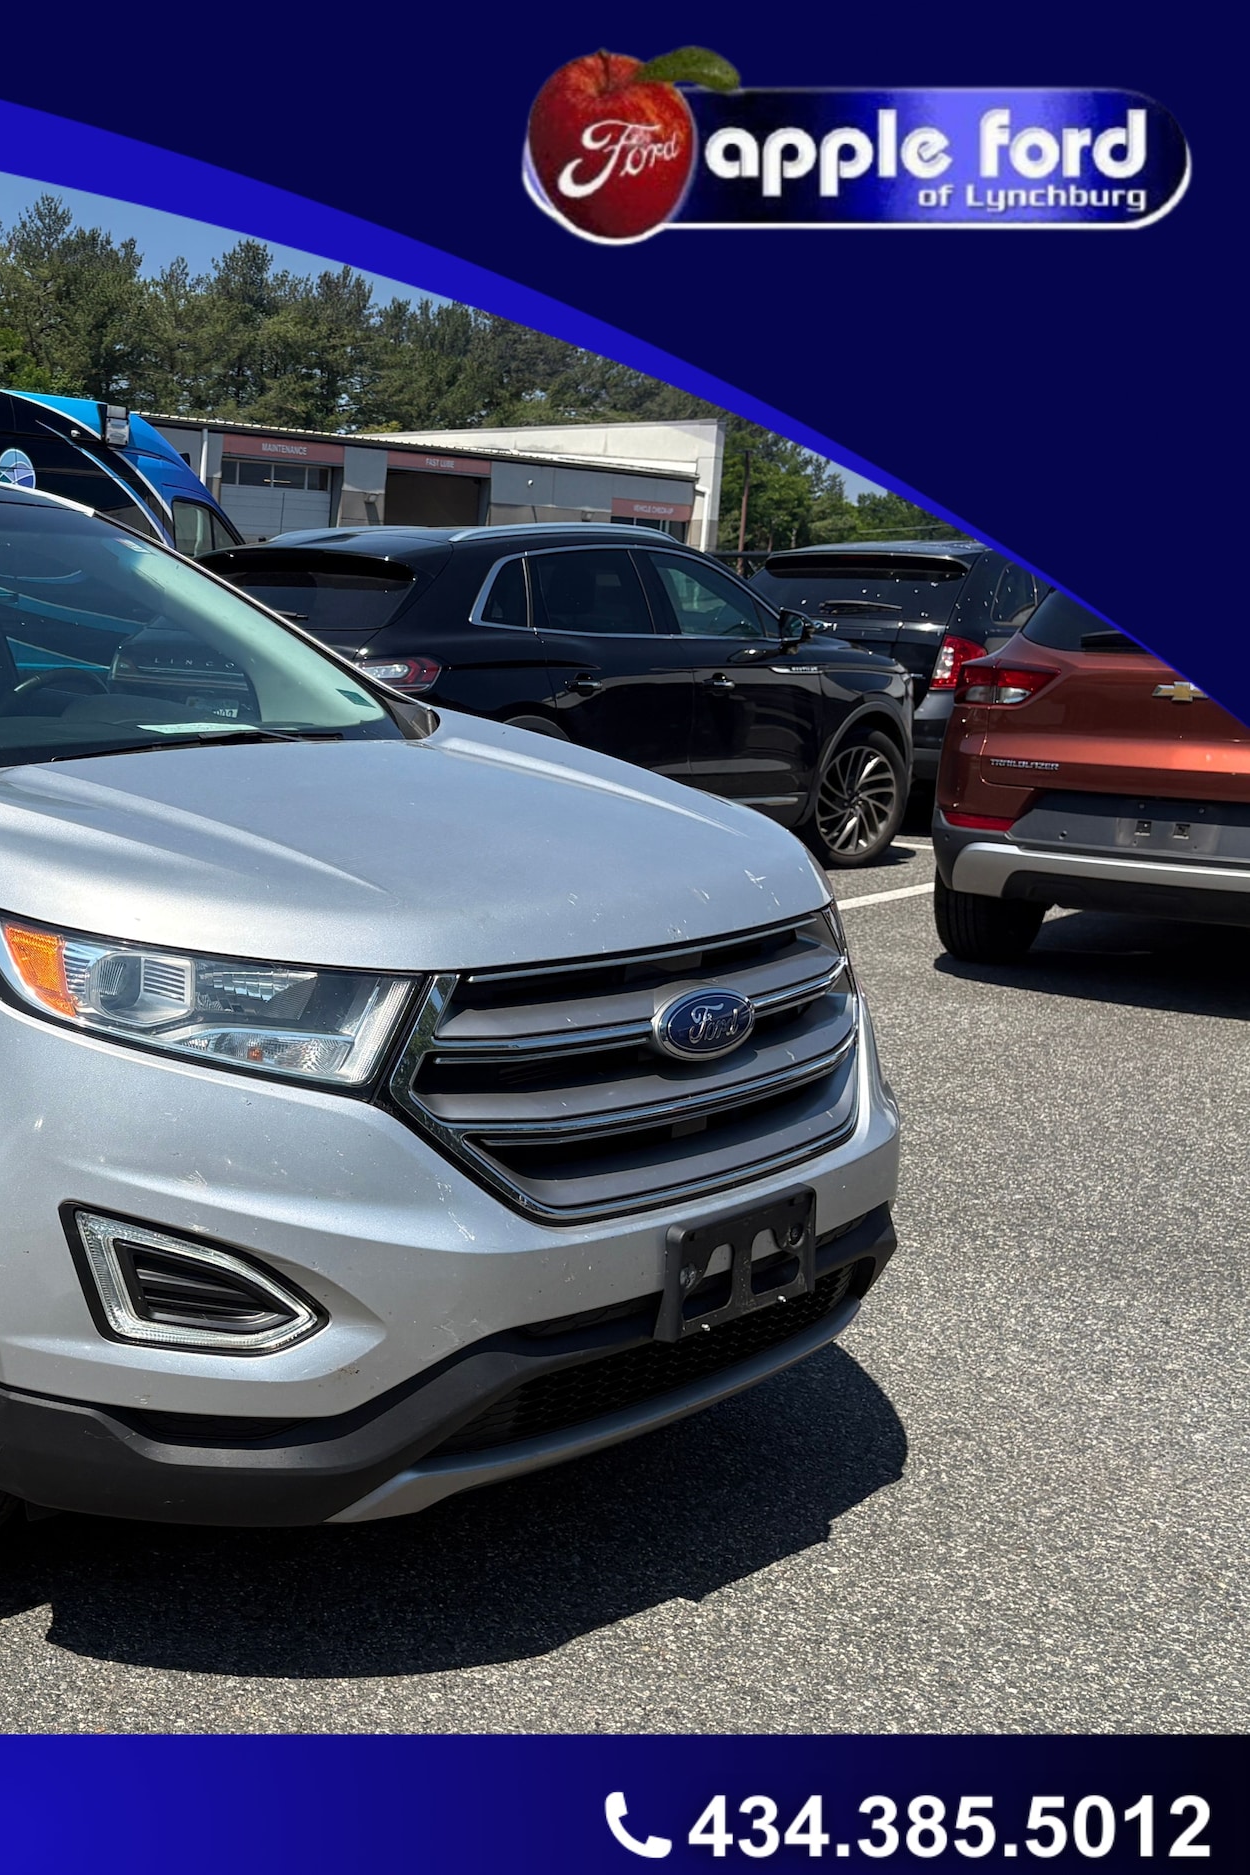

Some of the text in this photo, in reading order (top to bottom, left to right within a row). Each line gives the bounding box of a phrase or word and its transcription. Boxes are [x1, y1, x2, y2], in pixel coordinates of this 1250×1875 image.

[261, 442, 308, 456] MAINTENANCE
[425, 458, 439, 467] FAST
[154, 658, 235, 669] LINCO
[990, 758, 1059, 771] TRAILBLAZER
[688, 1002, 740, 1044] Ford
